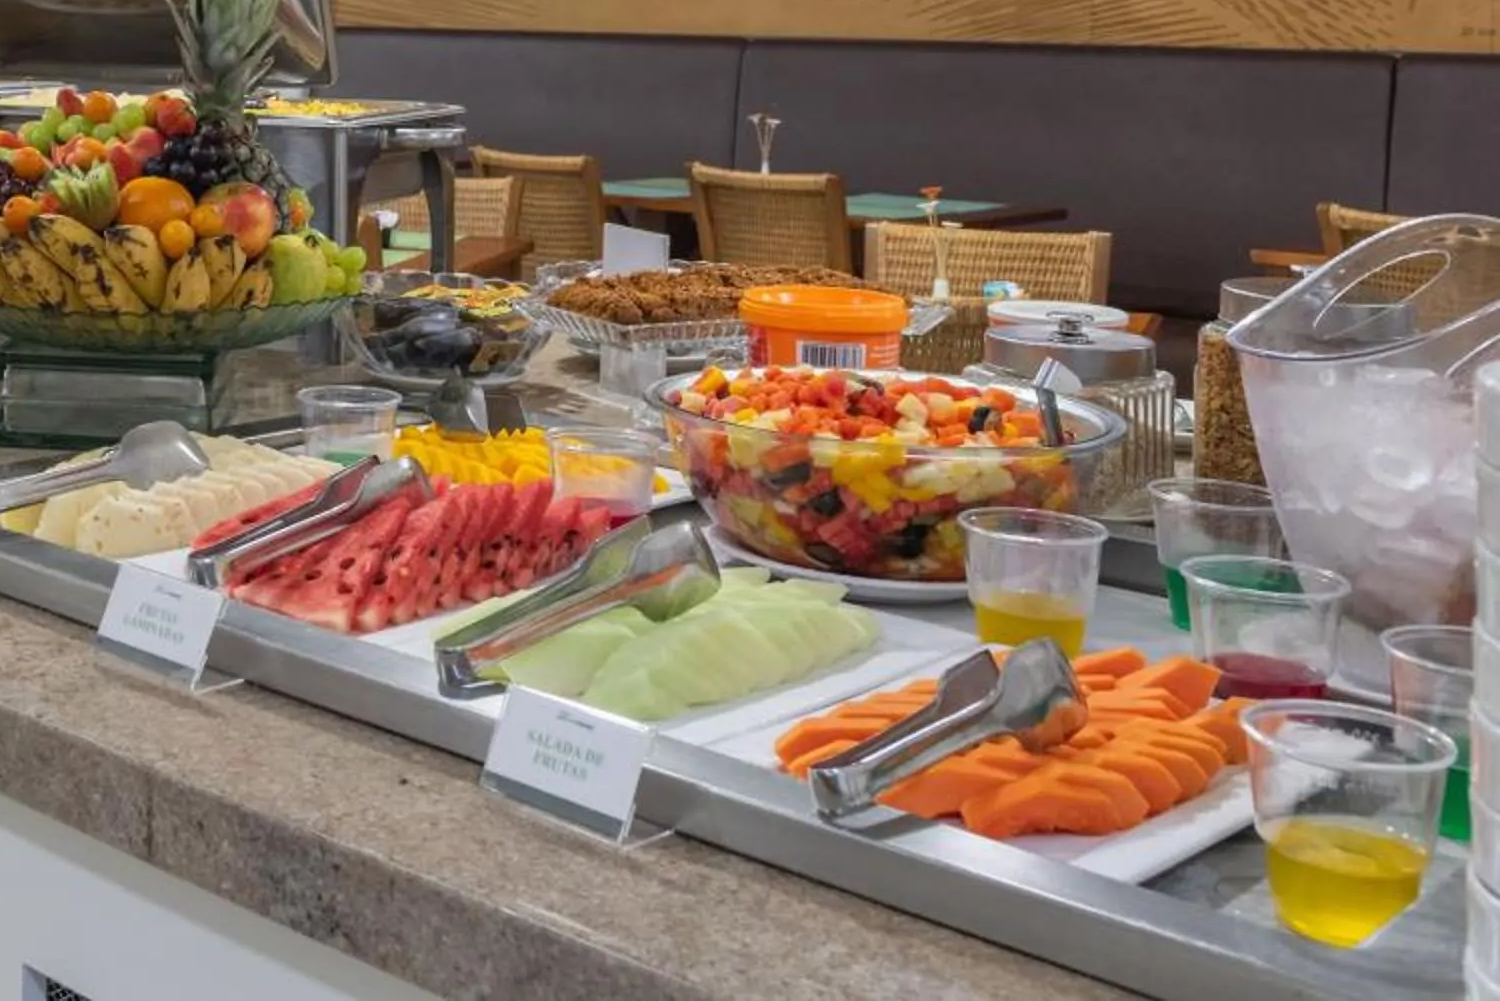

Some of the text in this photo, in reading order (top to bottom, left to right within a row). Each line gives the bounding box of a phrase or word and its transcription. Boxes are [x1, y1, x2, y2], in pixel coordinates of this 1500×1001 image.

[528, 730, 604, 765] SALADA DE
[532, 750, 588, 781] FRUTAS
